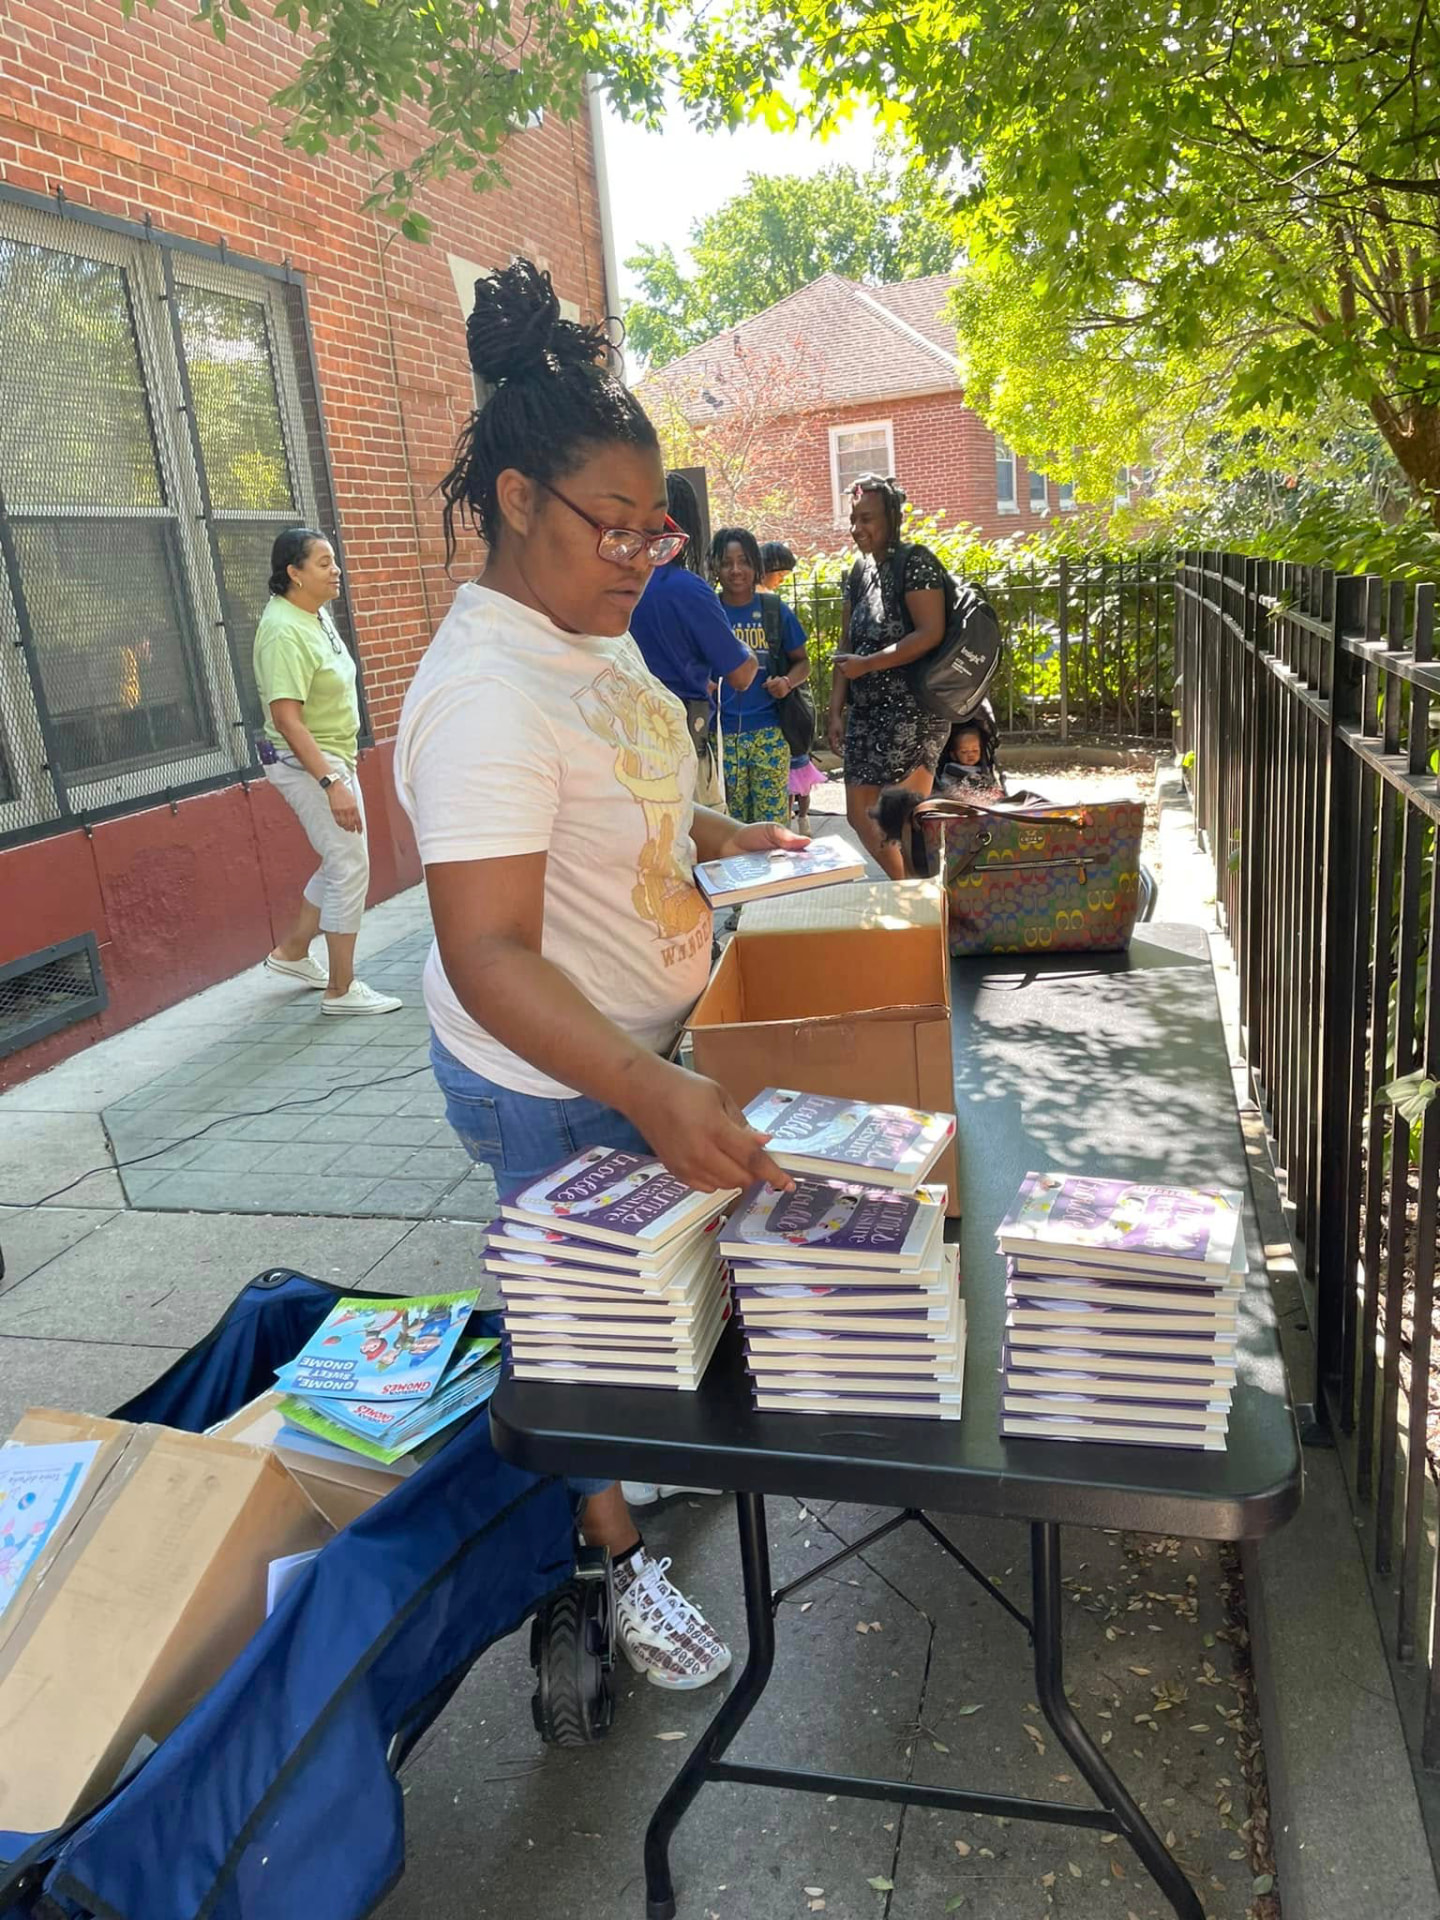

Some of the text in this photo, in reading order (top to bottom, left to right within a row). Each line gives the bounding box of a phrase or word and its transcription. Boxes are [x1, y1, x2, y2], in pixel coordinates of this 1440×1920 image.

[557, 1154, 639, 1200] trouble
[300, 1357, 354, 1370] GNOME
[297, 1377, 355, 1390] GNOME,
[381, 1381, 431, 1394] GNOMES
